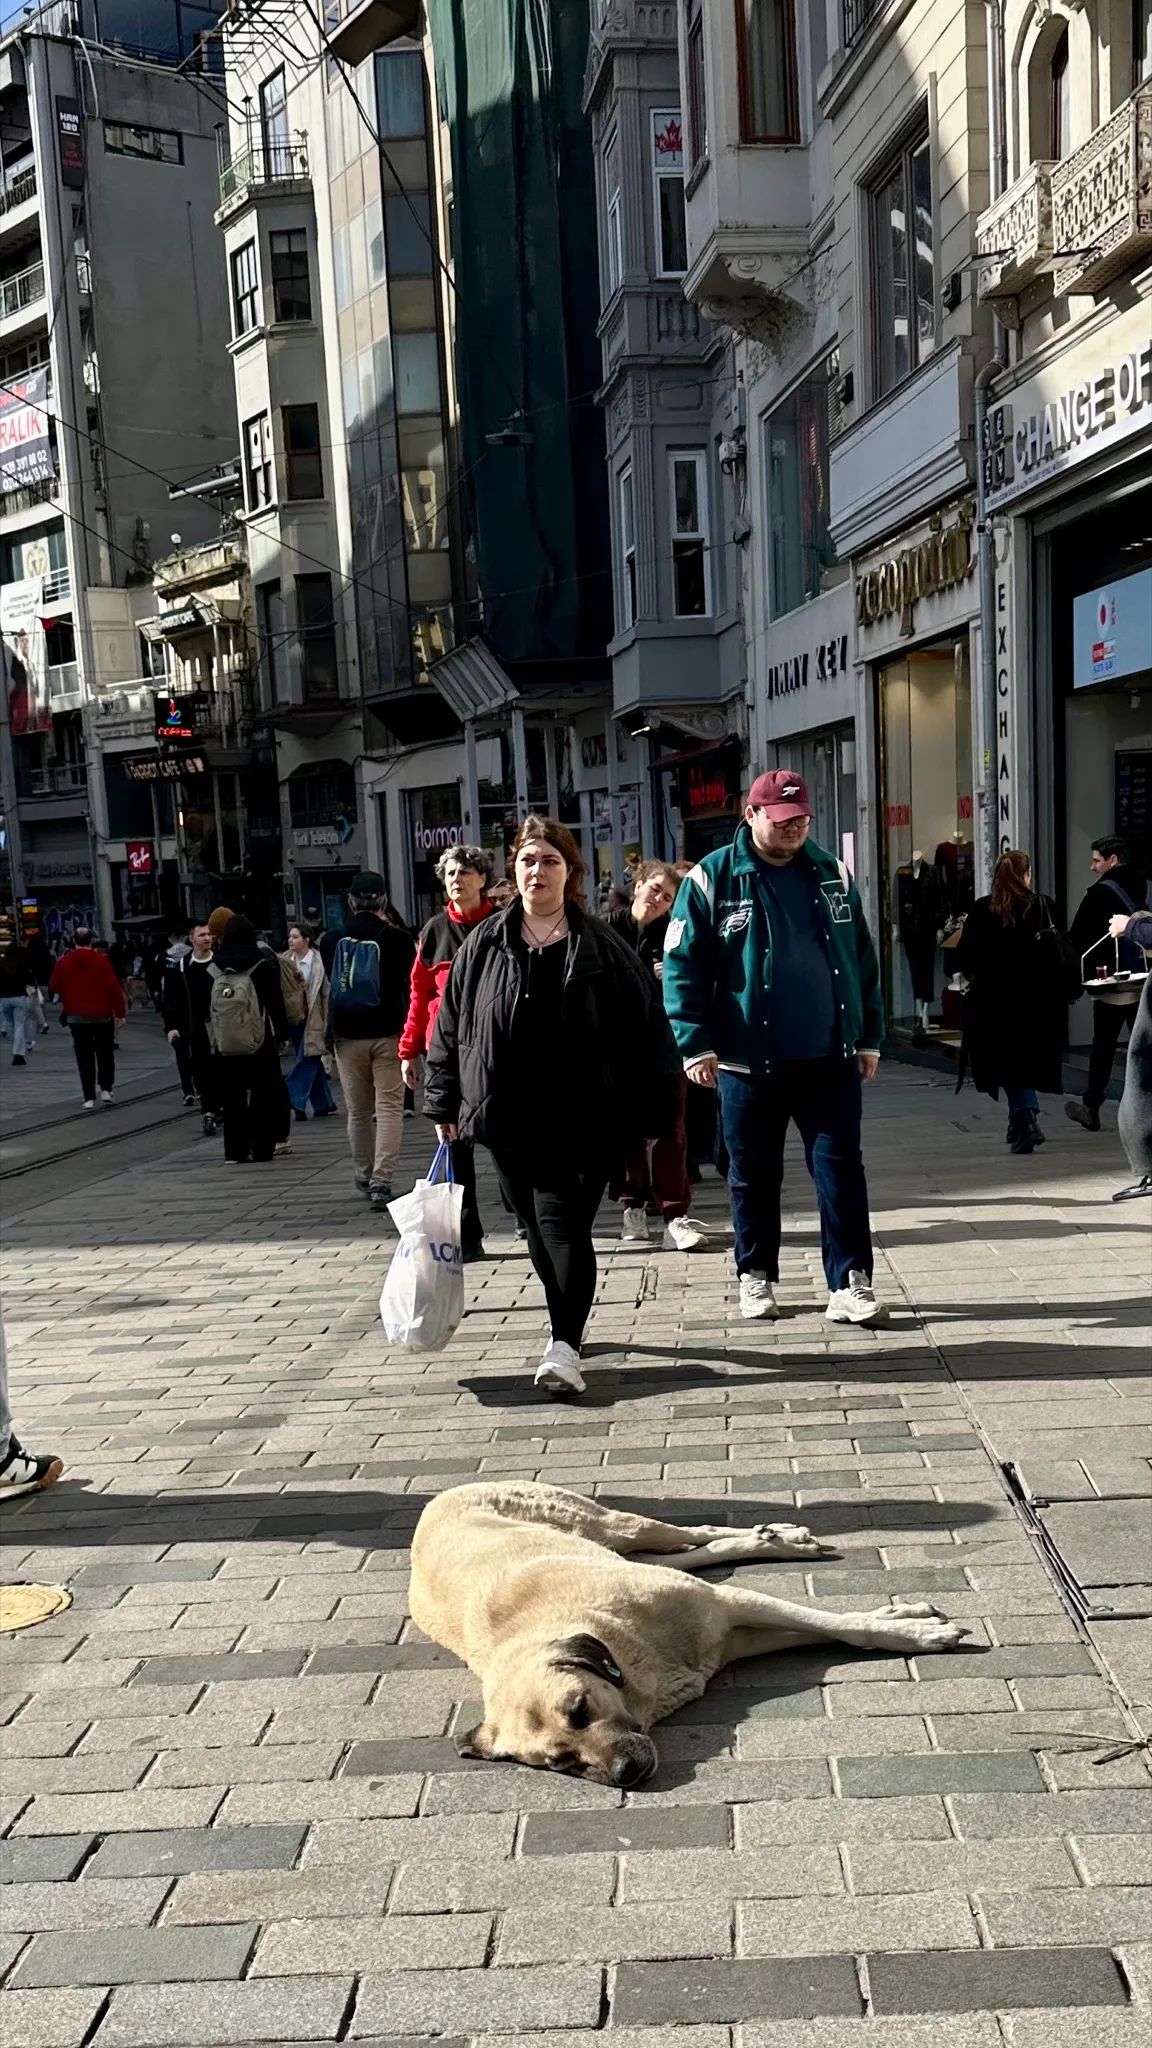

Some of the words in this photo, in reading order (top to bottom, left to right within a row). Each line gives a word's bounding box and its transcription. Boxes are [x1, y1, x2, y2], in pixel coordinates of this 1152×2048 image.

[1013, 375, 1107, 471] CHANGE
[766, 652, 809, 701] JIMMY
[816, 633, 848, 680] KEY
